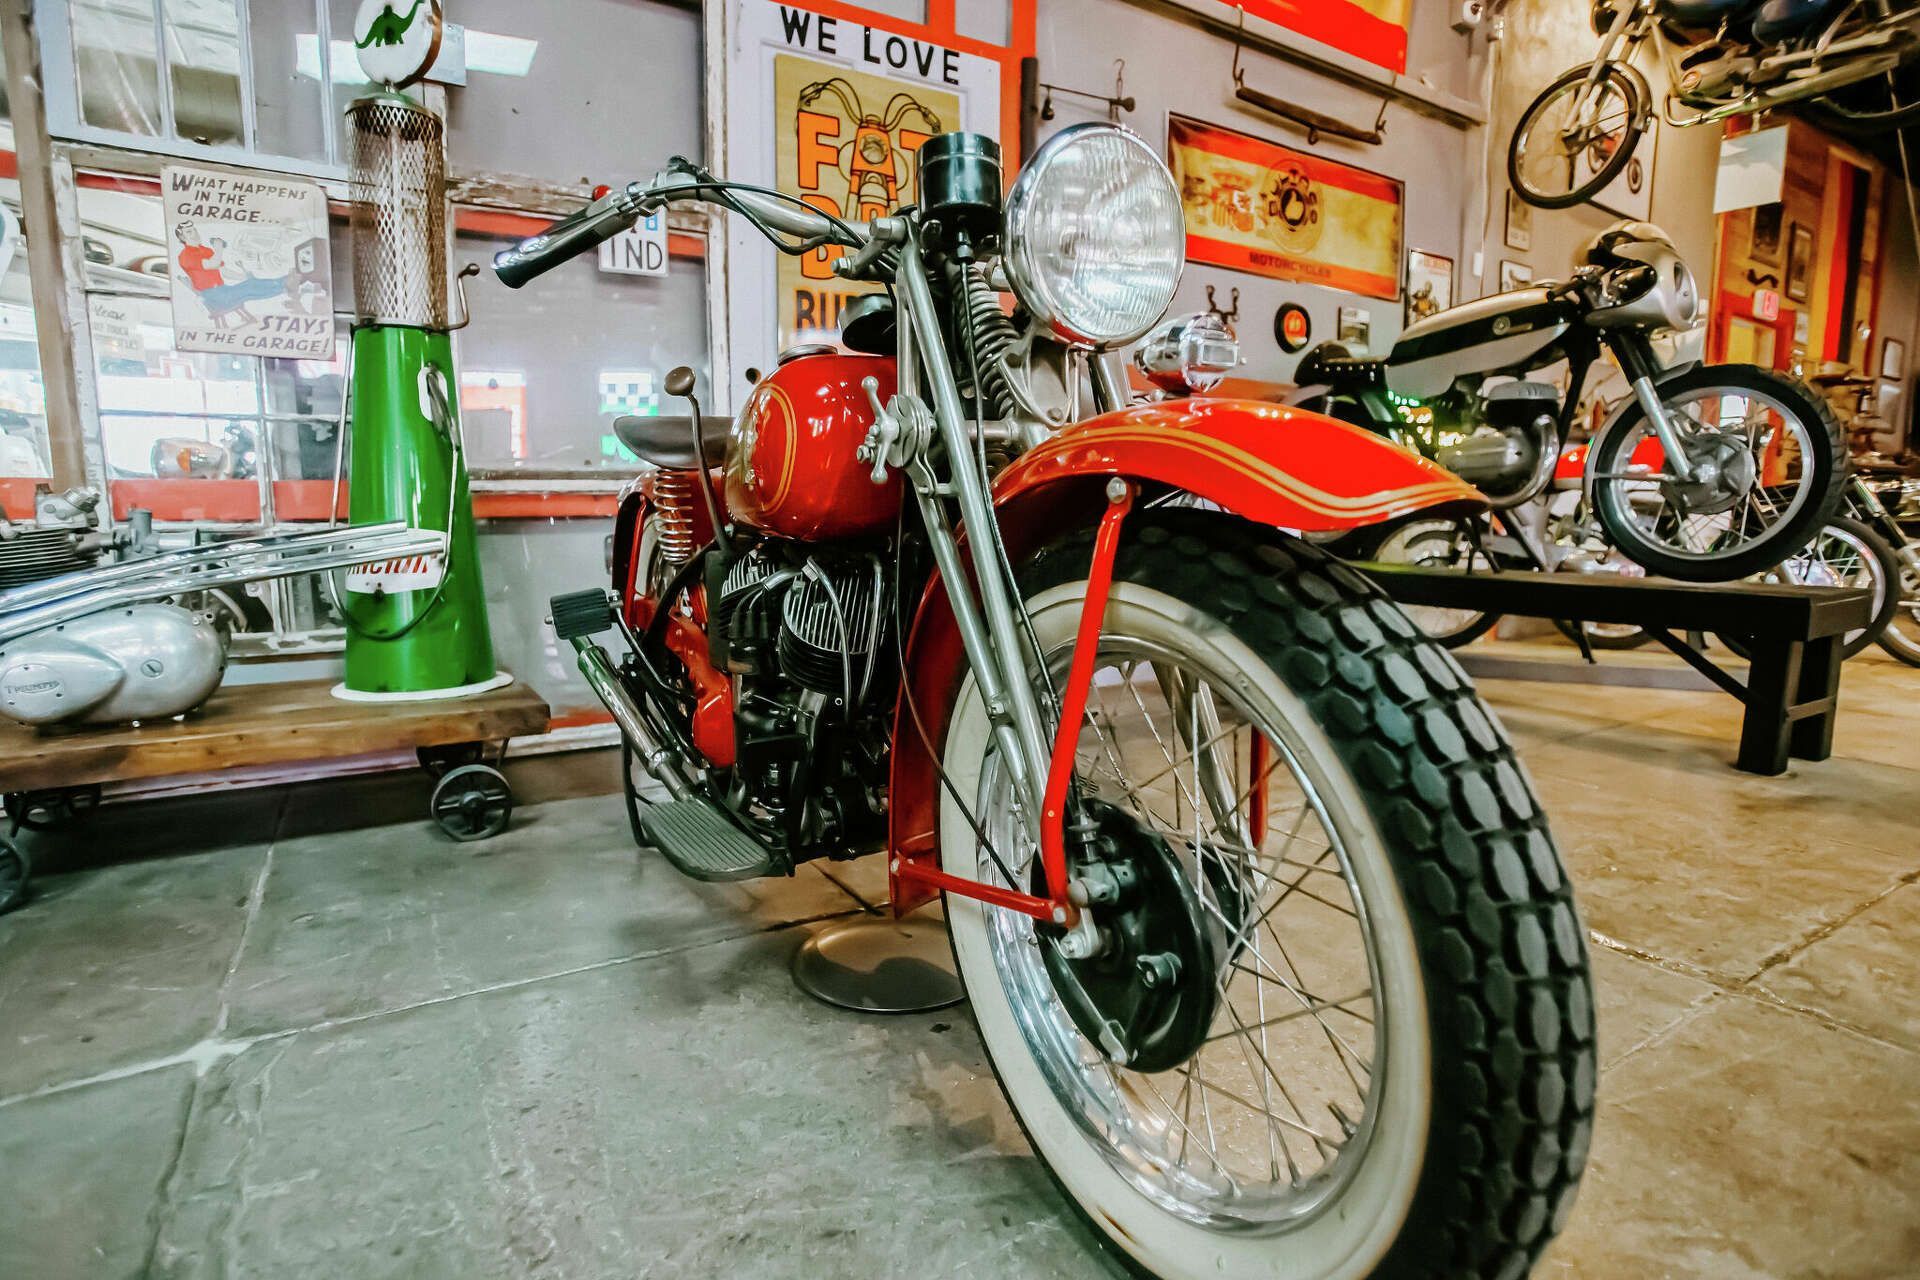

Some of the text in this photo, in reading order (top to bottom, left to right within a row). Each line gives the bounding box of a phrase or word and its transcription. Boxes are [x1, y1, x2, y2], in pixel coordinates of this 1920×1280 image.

[780, 5, 960, 86] WE LOVE
[172, 172, 308, 201] WHAT HAPPENS
[194, 190, 247, 206] IN THE
[611, 237, 663, 270] IND
[259, 315, 329, 335] STAYS
[179, 330, 331, 353] IN THE GARAGE!
